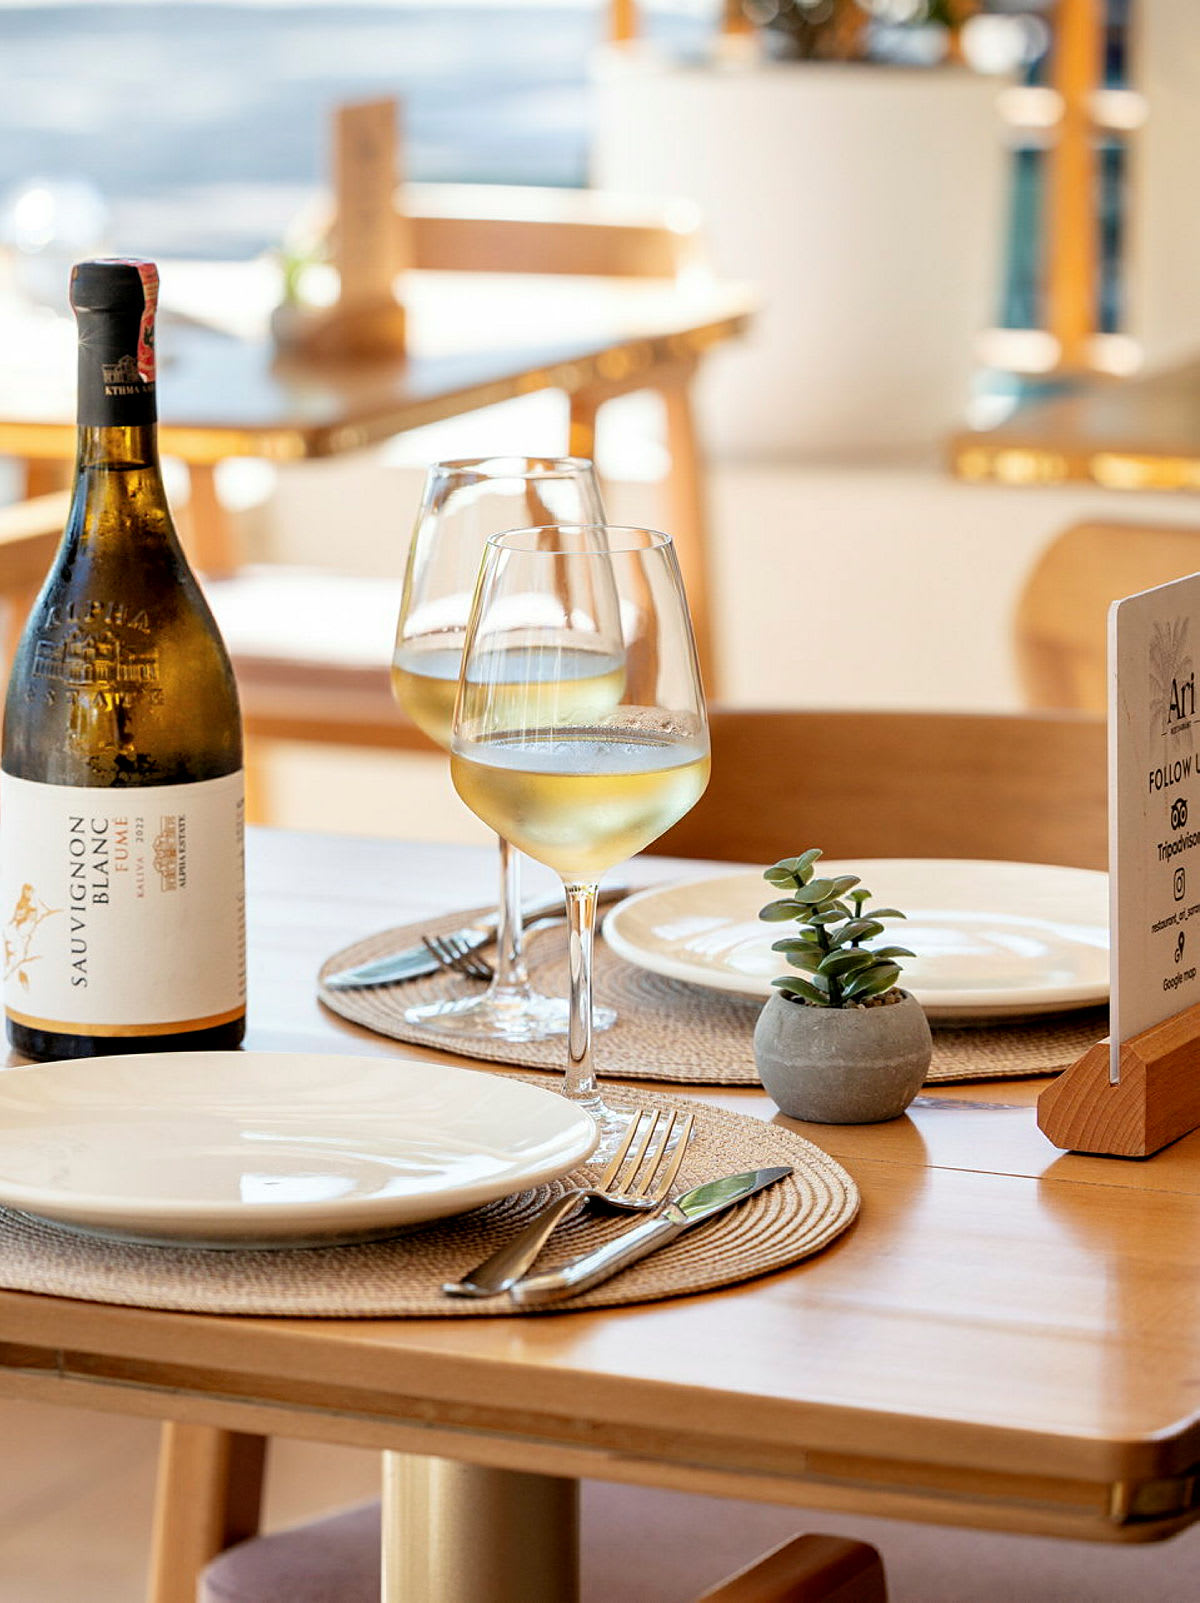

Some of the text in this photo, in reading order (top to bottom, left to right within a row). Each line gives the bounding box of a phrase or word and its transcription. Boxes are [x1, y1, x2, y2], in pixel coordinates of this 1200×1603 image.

[1167, 671, 1196, 725] Ari
[1149, 756, 1192, 794] FOLLOW
[92, 818, 110, 905] BLANC
[136, 817, 145, 898] KALIVA 2022
[178, 815, 187, 889] ALPHA ESTATE
[69, 815, 88, 988] SAUVIGNON
[1163, 972, 1183, 991] Google
